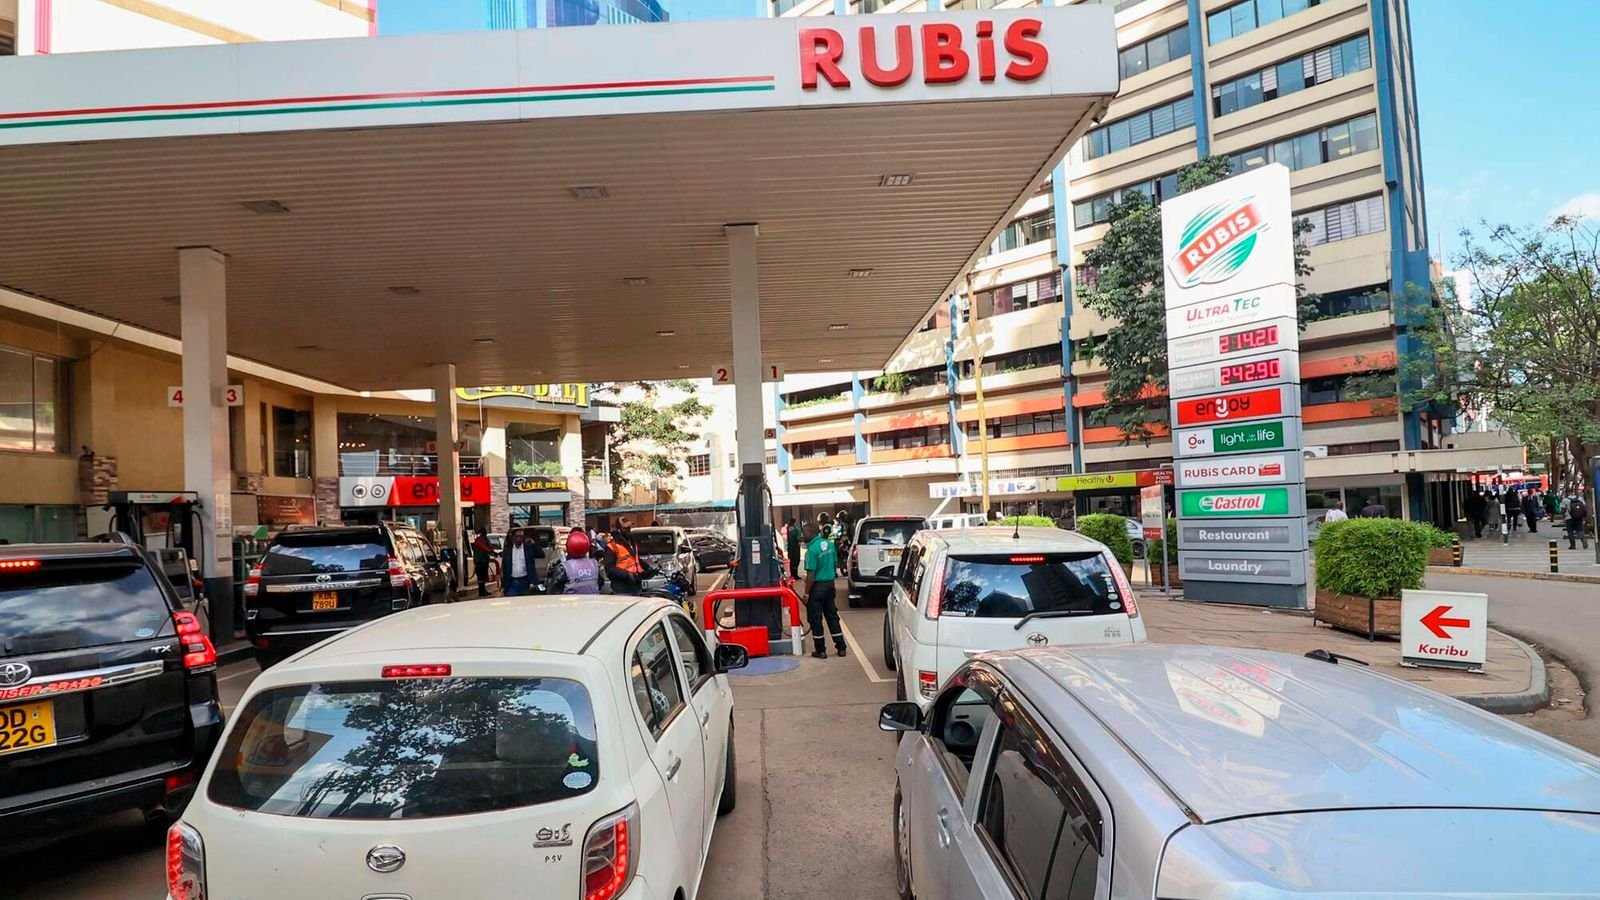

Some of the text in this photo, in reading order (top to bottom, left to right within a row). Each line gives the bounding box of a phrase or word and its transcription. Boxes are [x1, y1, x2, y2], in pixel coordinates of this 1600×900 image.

[1185, 211, 1253, 267] RUBIS
[1220, 327, 1277, 353] 214.20
[717, 368, 728, 381] 2
[770, 366, 777, 378] 1
[1221, 360, 1279, 384] 242.90
[172, 390, 184, 403] 4
[226, 389, 237, 402] 3
[1220, 433, 1245, 446] light
[1257, 429, 1275, 441] life
[1221, 466, 1256, 476] CARD
[1077, 475, 1105, 485] Healthy
[1214, 495, 1260, 510] Castrol
[1199, 530, 1270, 541] Restaurant
[1208, 560, 1262, 575] Laundry
[314, 600, 335, 609] 789U
[151, 644, 172, 653] TX
[1418, 643, 1469, 657] Karibu
[544, 854, 562, 864] PSV
